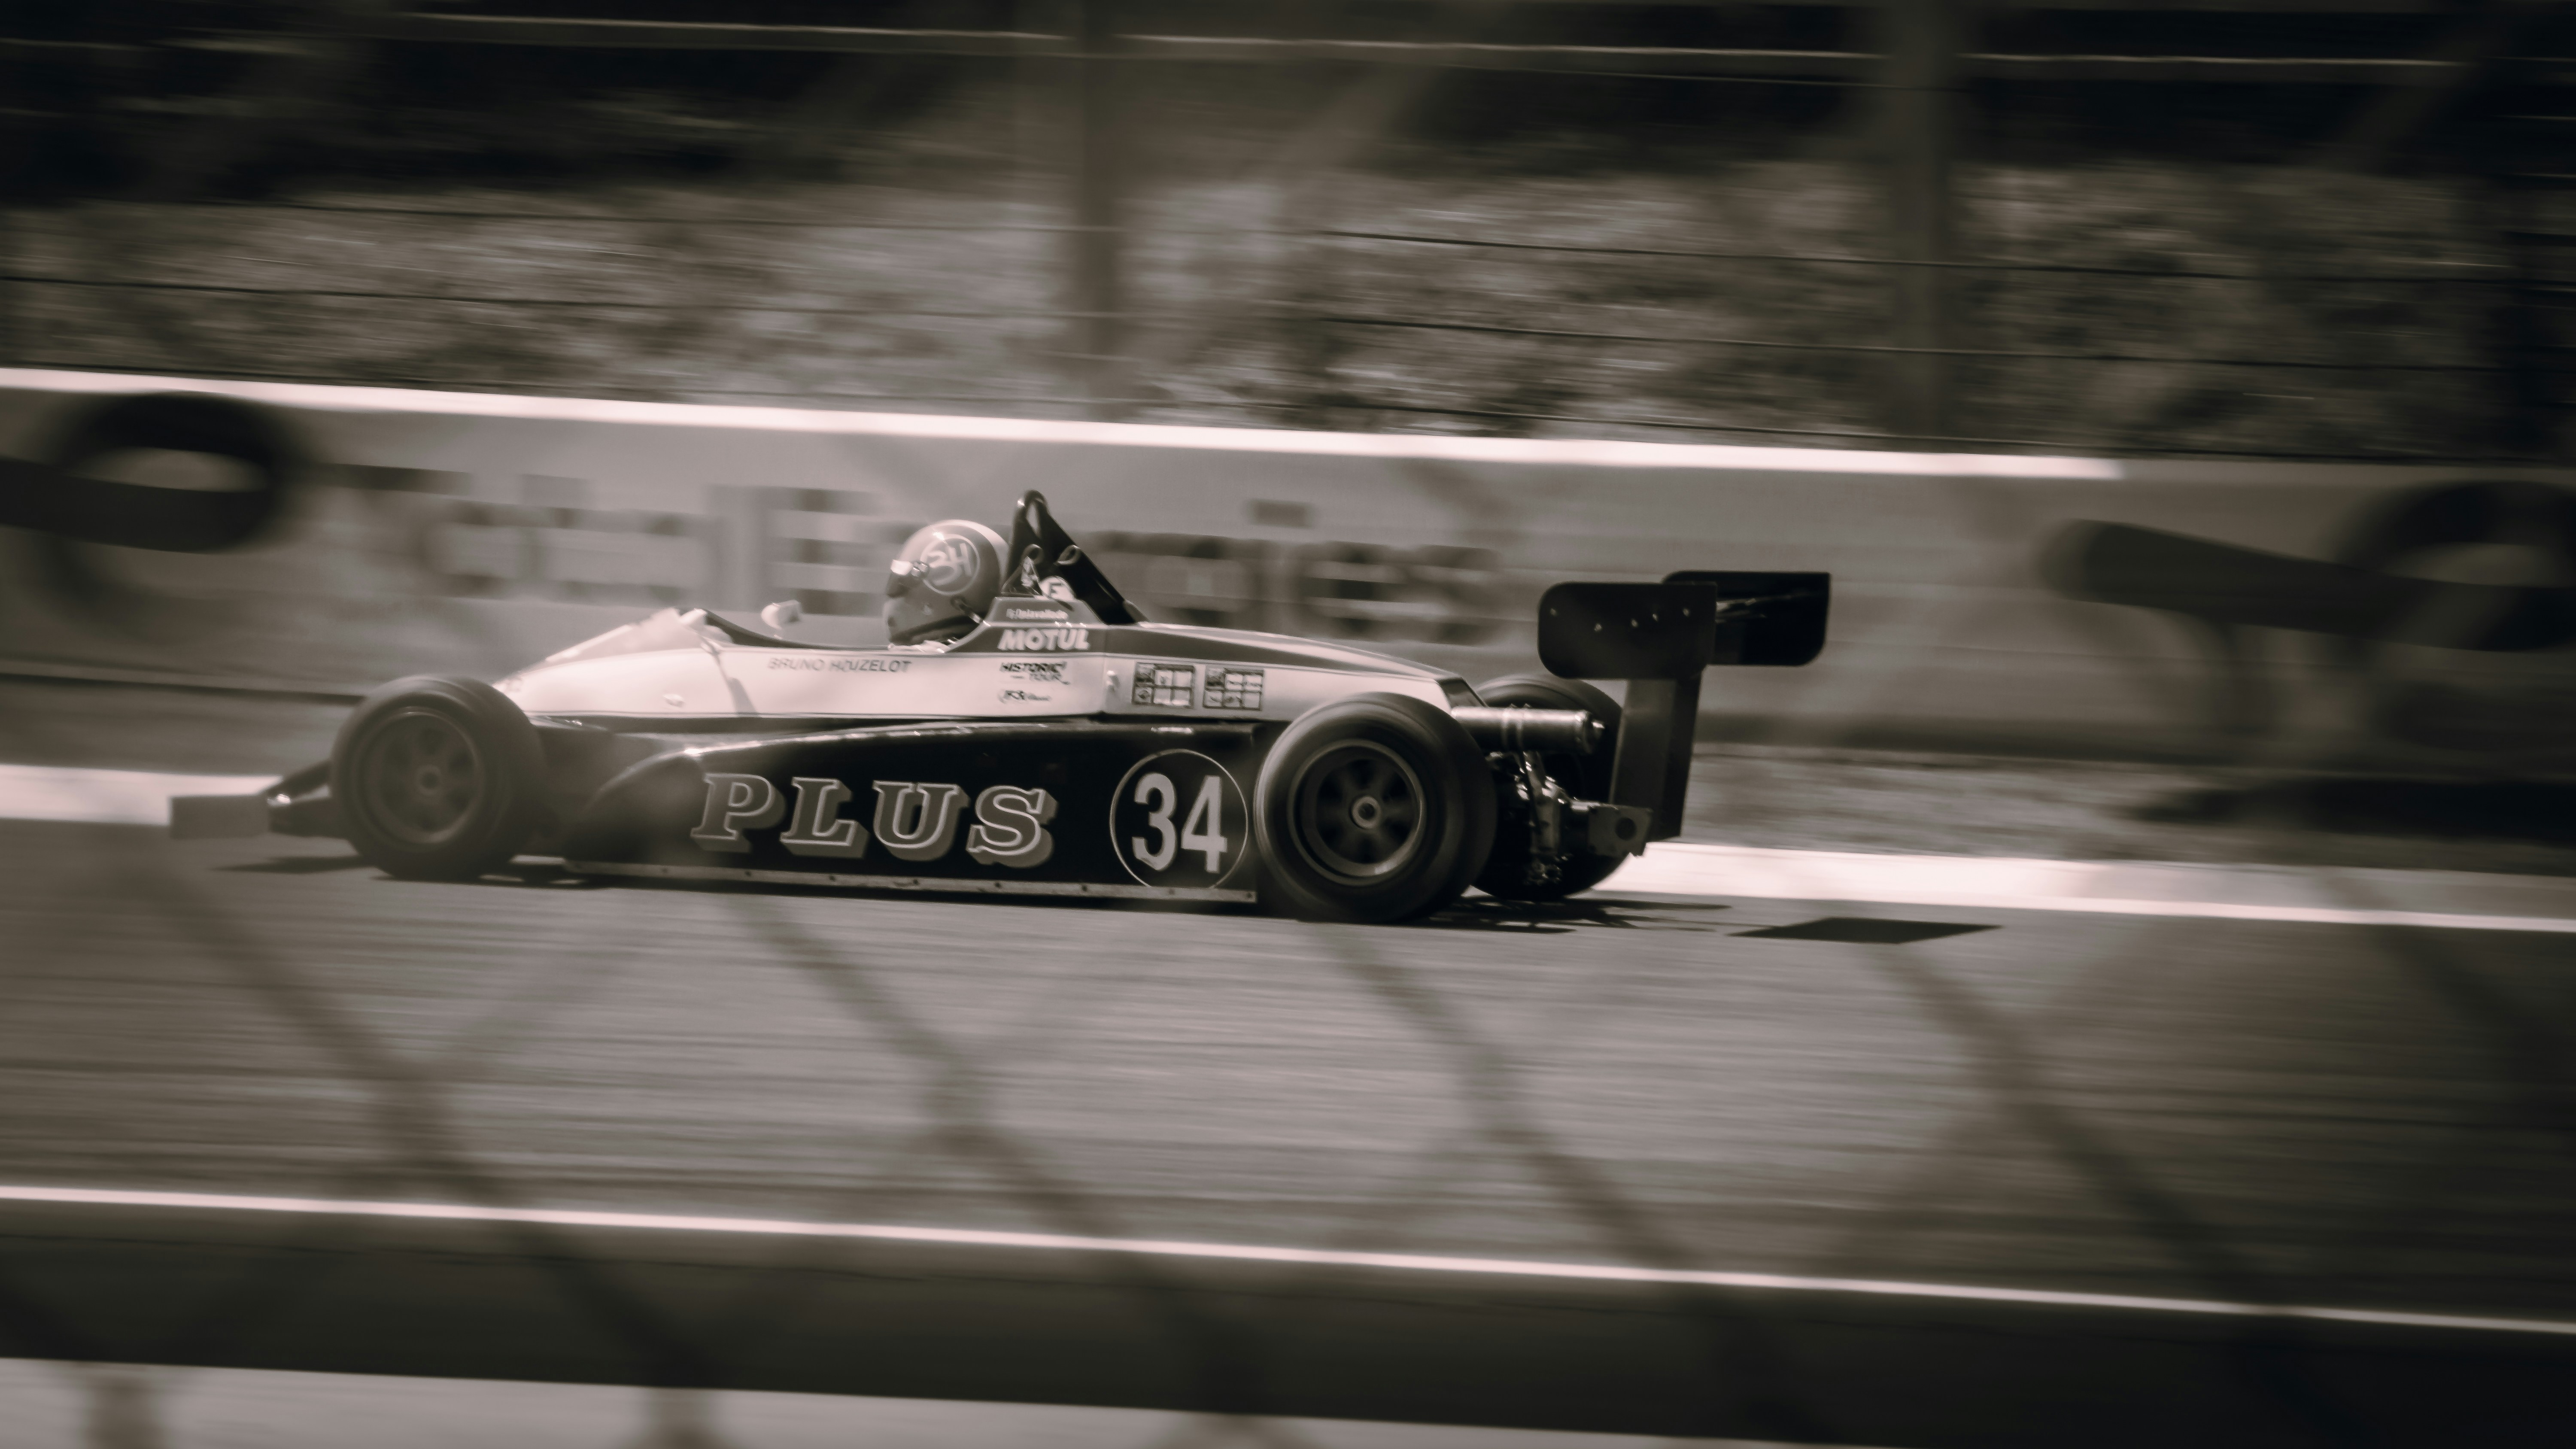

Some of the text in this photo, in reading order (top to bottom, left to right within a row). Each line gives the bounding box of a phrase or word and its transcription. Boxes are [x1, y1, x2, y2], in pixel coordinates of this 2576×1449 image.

[769, 657, 825, 671] BRUNO
[997, 629, 1091, 650] MOTUL
[690, 772, 1058, 868] PLUS
[1132, 773, 1228, 873] 34
